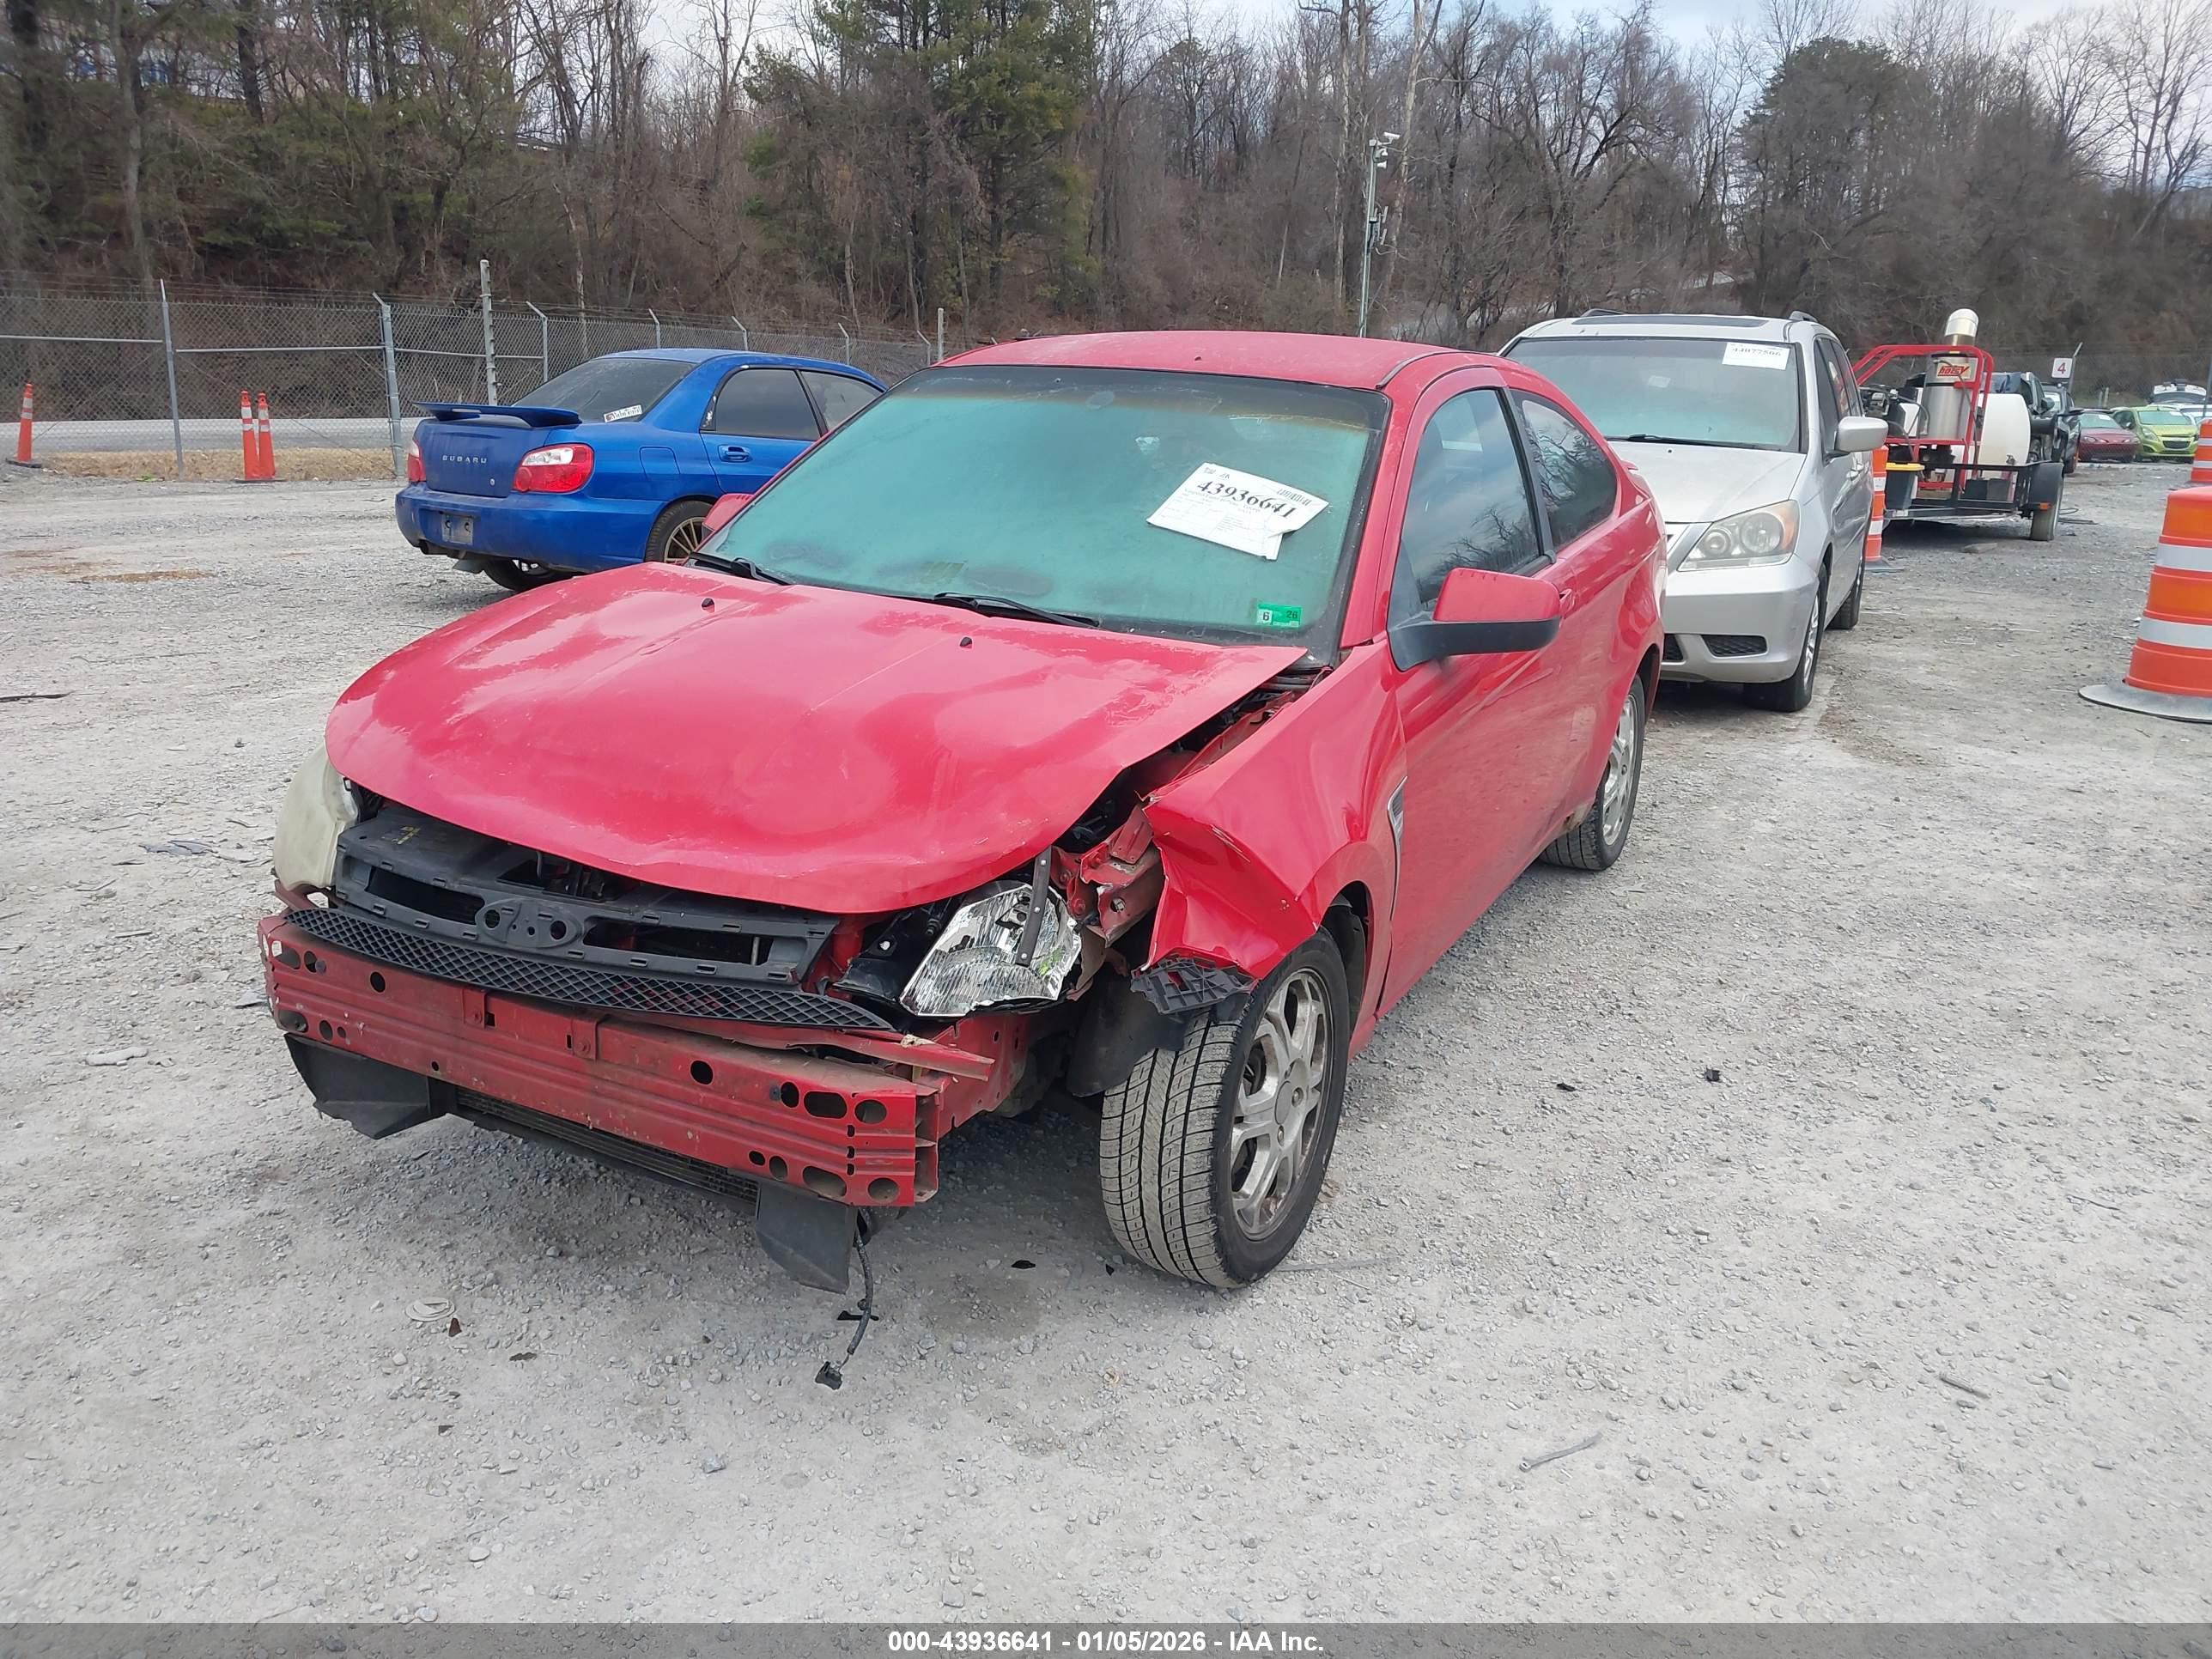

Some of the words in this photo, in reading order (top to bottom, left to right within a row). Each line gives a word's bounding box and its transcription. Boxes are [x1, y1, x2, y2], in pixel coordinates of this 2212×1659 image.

[2057, 362, 2067, 374] 4
[442, 454, 487, 464] SUBARU
[1196, 480, 1297, 519] 43936641
[1262, 611, 1270, 622] 6
[1286, 610, 1298, 619] 26
